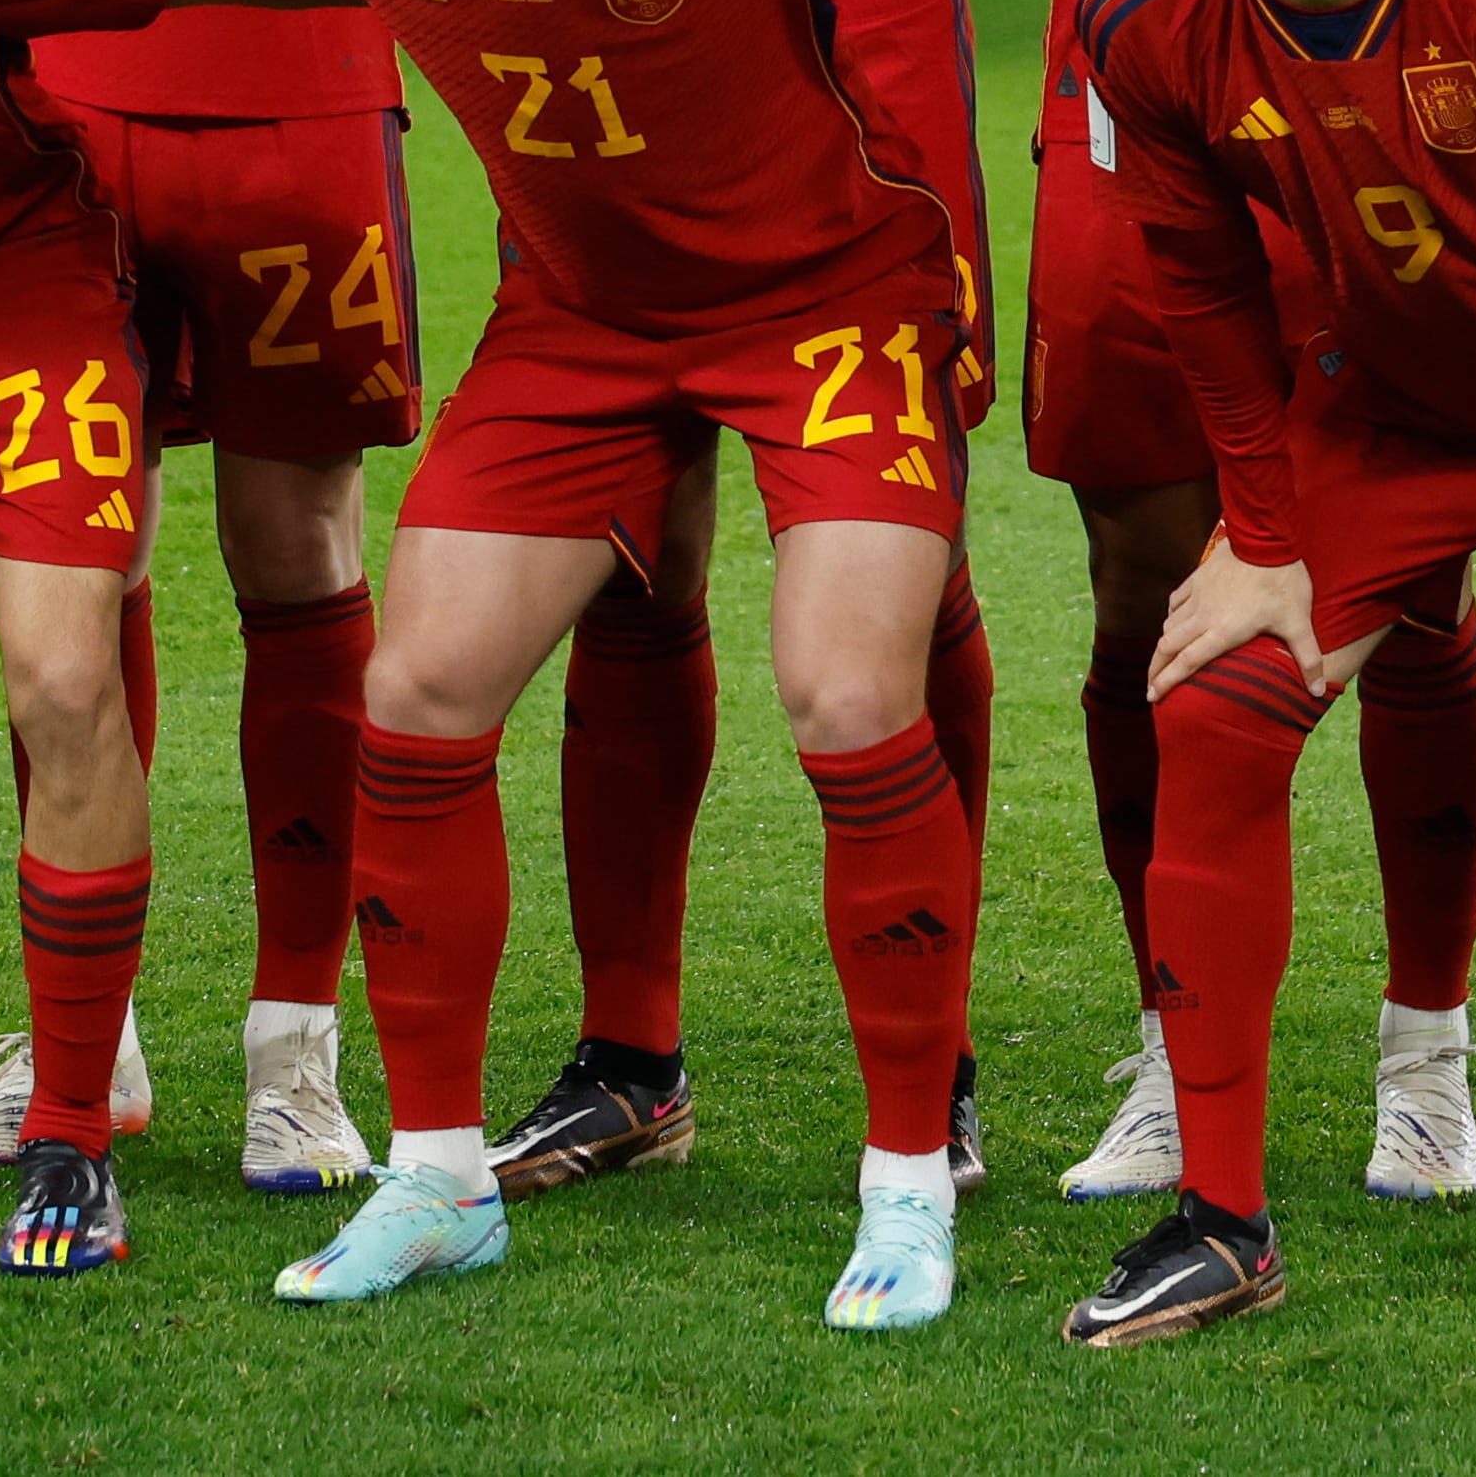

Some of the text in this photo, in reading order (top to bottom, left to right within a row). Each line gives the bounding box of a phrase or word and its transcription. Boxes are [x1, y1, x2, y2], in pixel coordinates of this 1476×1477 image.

[480, 52, 647, 158] 21
[1354, 185, 1444, 284] 9
[239, 224, 402, 367] 24
[794, 323, 936, 449] 21
